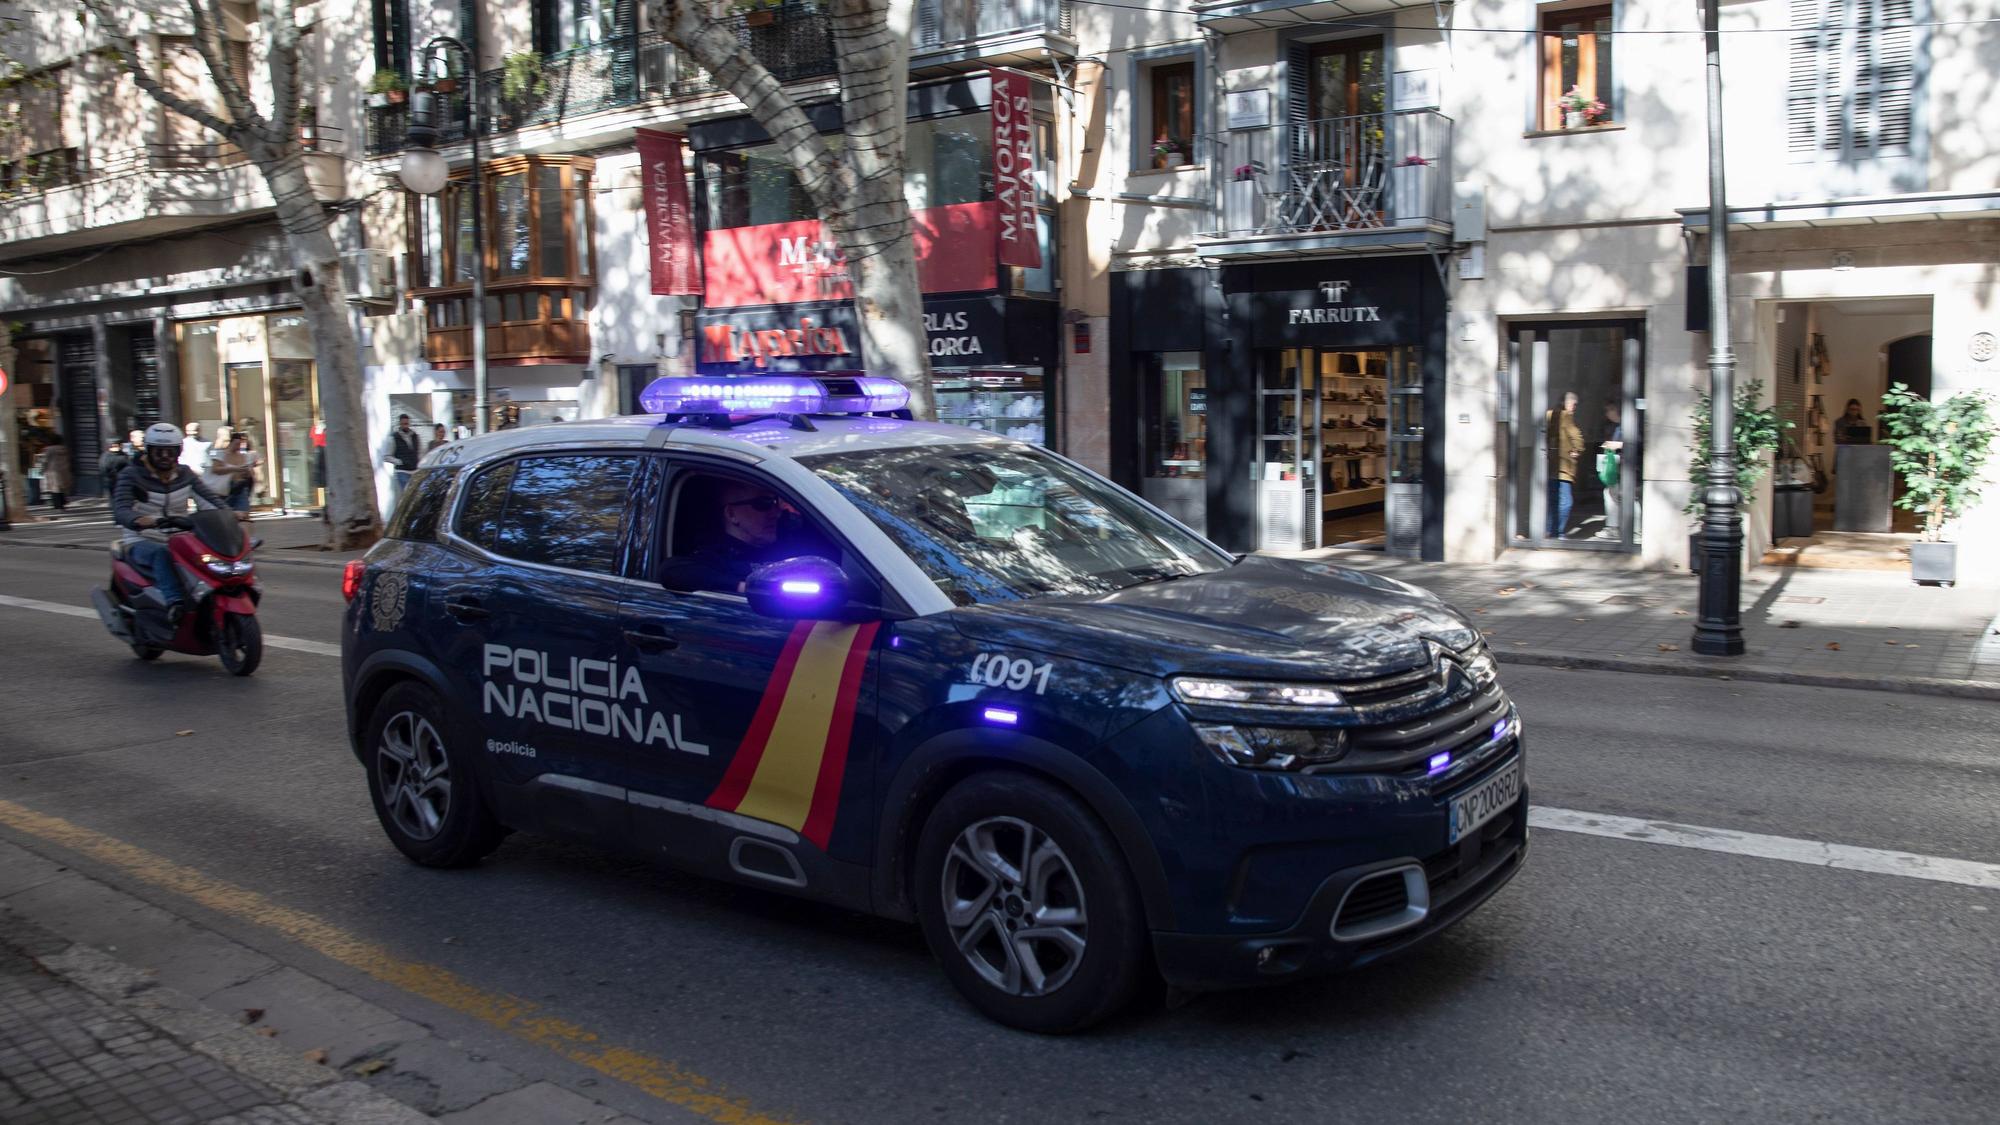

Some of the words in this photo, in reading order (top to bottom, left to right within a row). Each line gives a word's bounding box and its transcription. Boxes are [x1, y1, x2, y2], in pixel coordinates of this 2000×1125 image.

[994, 78, 1019, 242] MAJORCA
[1014, 96, 1036, 230] PEARLS
[921, 311, 968, 332] RLAS
[1288, 306, 1381, 325] FARRUTX
[483, 642, 649, 704] POLICÍA
[985, 654, 1053, 695] 091
[483, 680, 710, 756] NACIONAL
[486, 738, 537, 758] @policia
